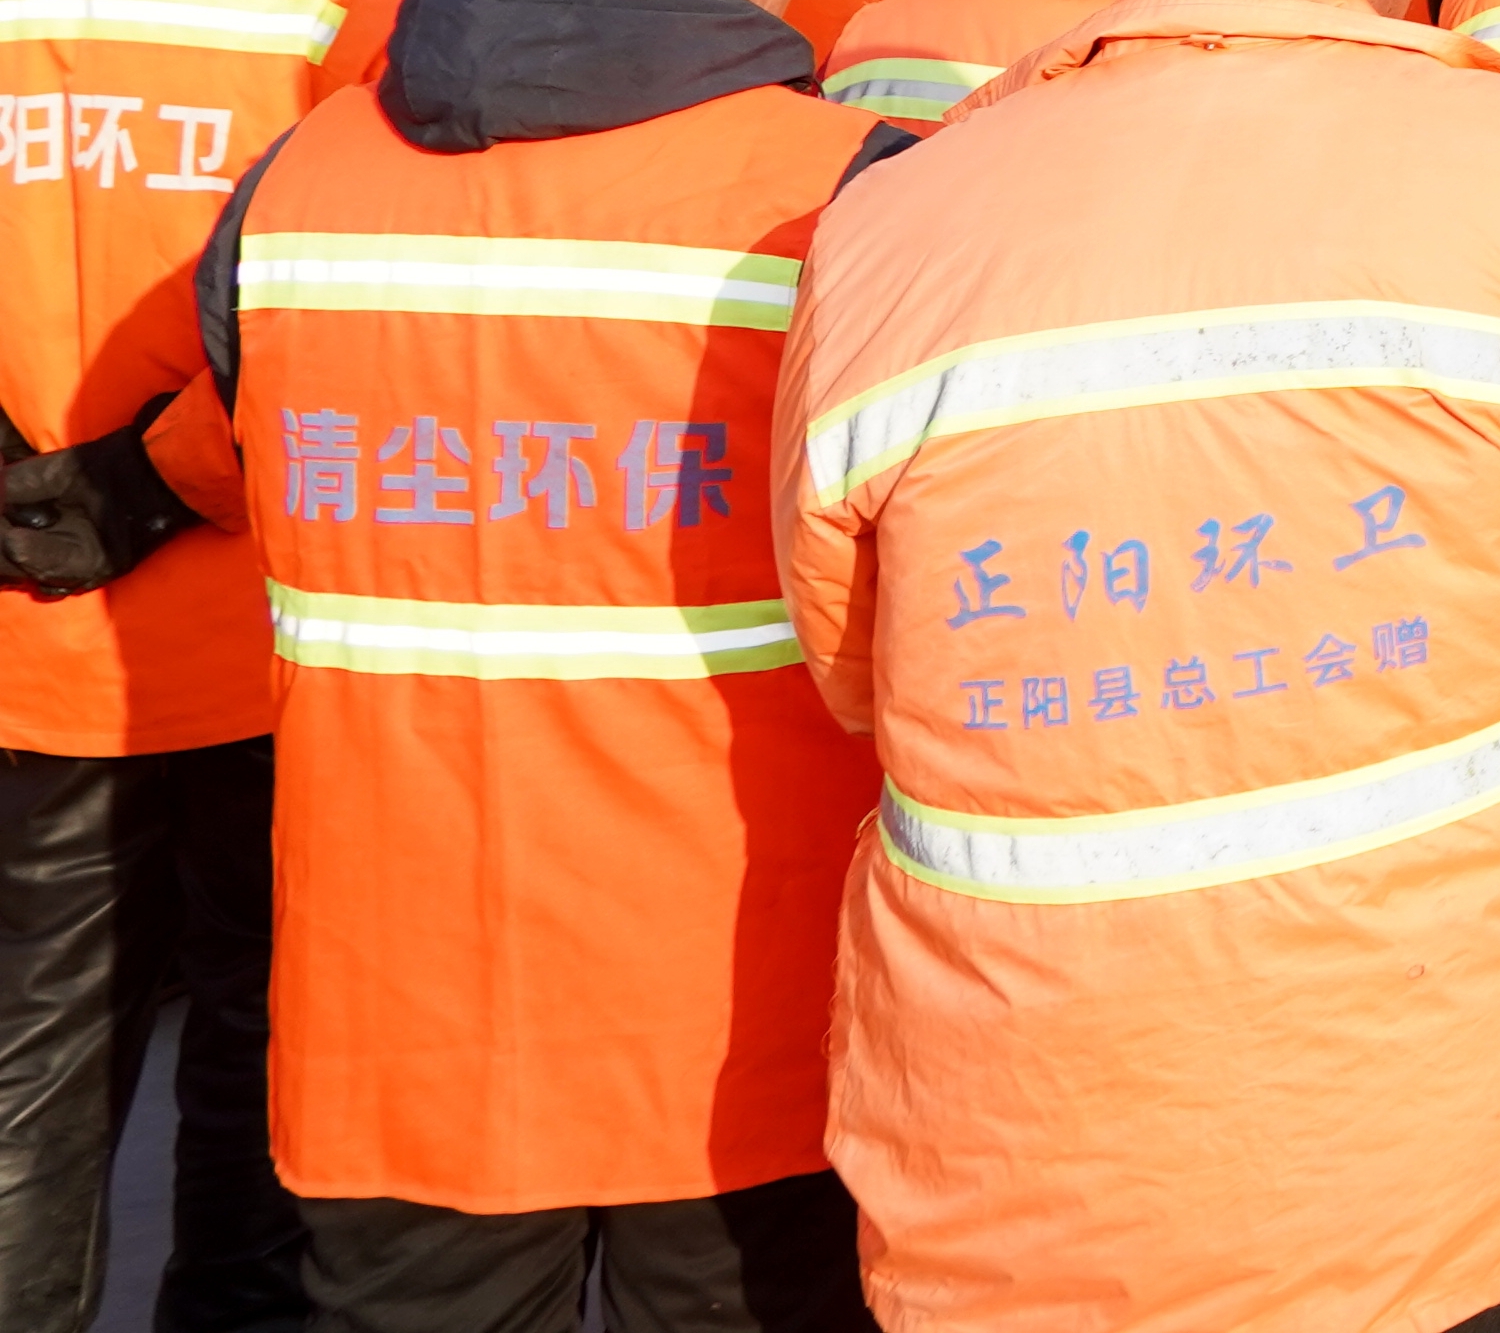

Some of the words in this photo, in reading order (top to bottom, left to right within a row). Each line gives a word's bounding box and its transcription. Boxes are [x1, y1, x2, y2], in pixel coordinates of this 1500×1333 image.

[279, 407, 733, 531] 清尘环保
[945, 483, 1427, 631] 正阳环卫
[959, 615, 1430, 732] 正阳县总工会赠
